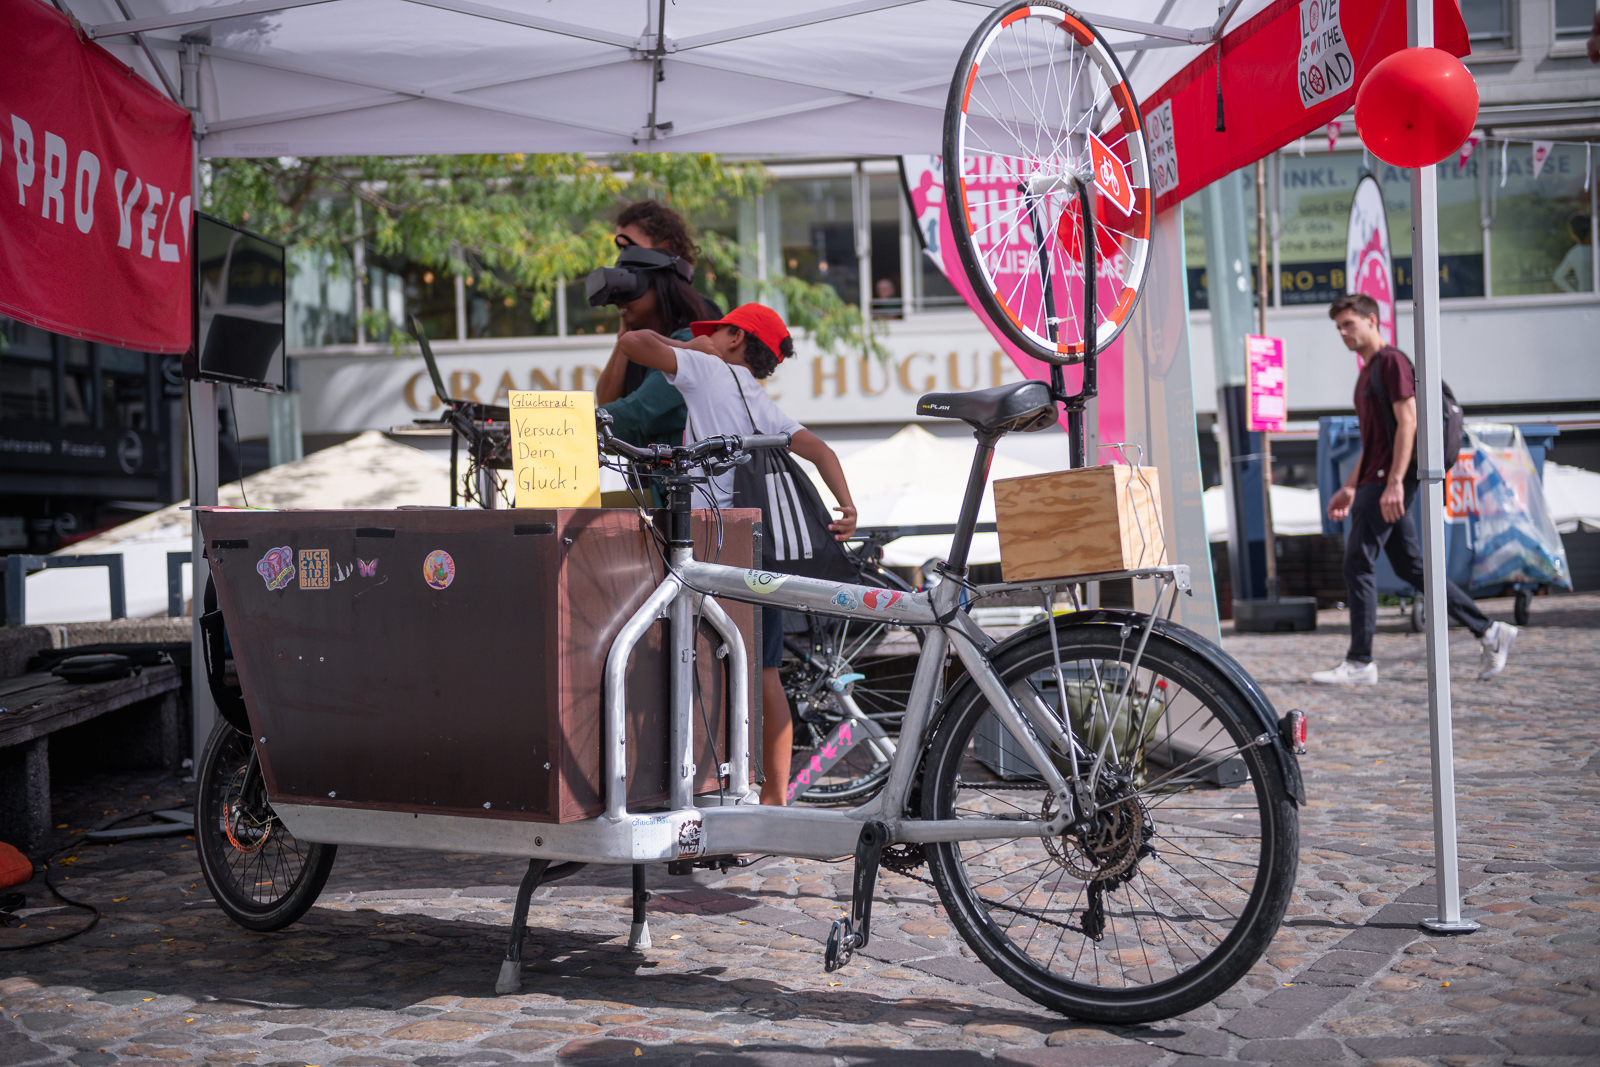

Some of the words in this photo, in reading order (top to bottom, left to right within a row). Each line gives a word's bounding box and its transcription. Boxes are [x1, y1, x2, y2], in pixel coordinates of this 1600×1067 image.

[1026, 0, 1081, 20] SCHWALBE
[1301, 0, 1337, 39] LOVE
[1300, 45, 1308, 64] IS
[1322, 25, 1342, 49] THE
[1300, 52, 1352, 102] ROAD
[1147, 105, 1172, 144] LOVE
[10, 113, 101, 235] PRO
[1153, 157, 1177, 192] ROAD
[511, 393, 575, 408] Glücksrad:
[515, 418, 575, 438] Versuch
[518, 441, 555, 459] Dein
[1452, 456, 1476, 479] BAS
[301, 552, 327, 560] FUCK
[301, 561, 328, 569] CARS
[301, 569, 328, 578] RIDE
[301, 578, 329, 587] BIKES
[1172, 661, 1216, 694] SCHWALBE
[631, 818, 656, 827] Critical
[656, 817, 672, 825] Mass
[678, 844, 699, 855] NAZI
